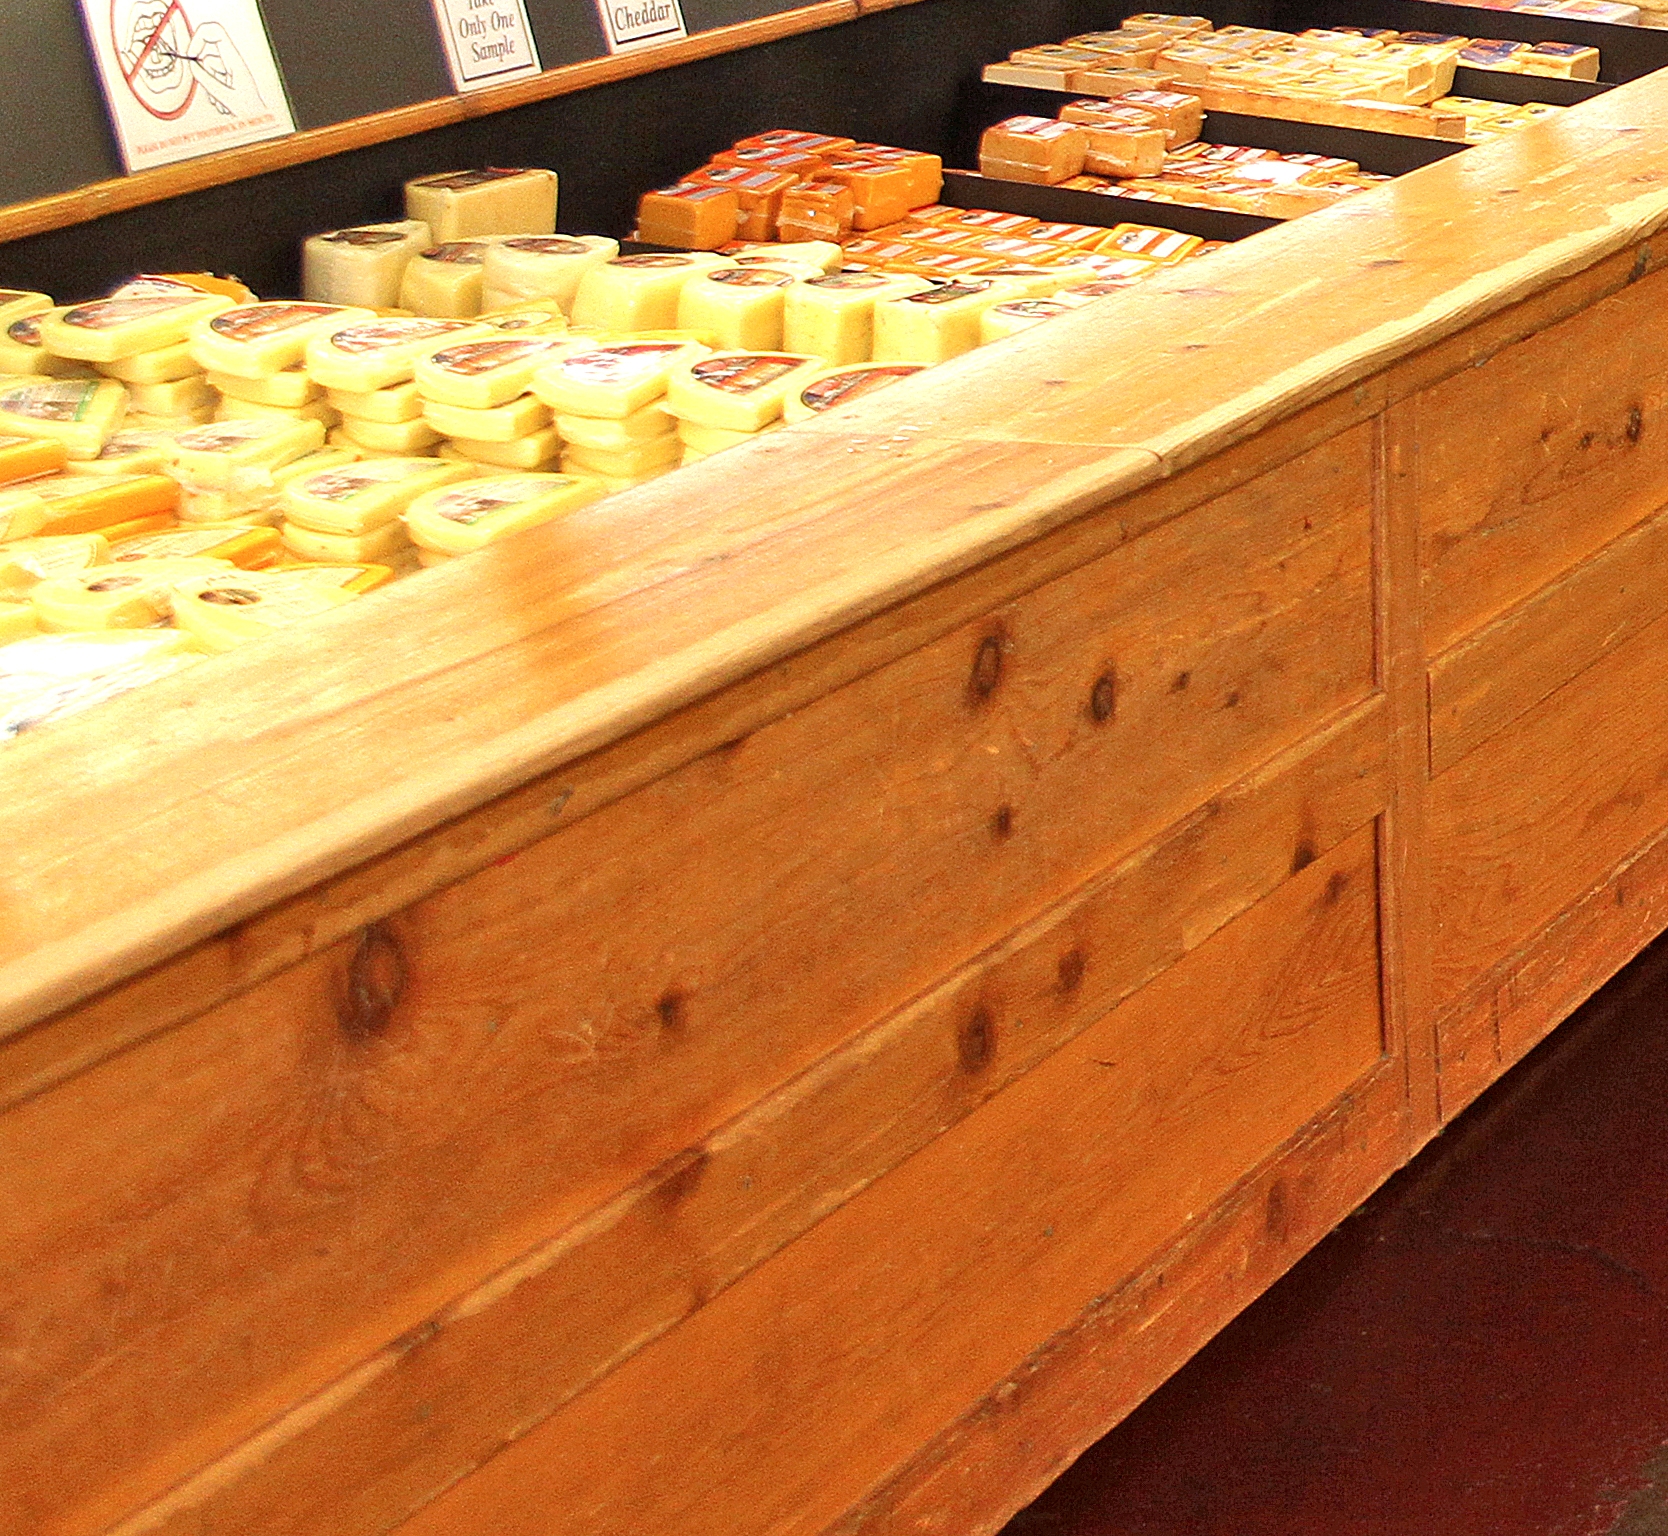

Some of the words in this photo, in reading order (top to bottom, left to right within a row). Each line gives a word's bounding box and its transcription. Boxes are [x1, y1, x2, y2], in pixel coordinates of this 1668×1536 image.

[458, 15, 488, 40] Only
[491, 11, 515, 32] One
[614, 0, 671, 31] Cheddar
[471, 34, 516, 64] Sample
